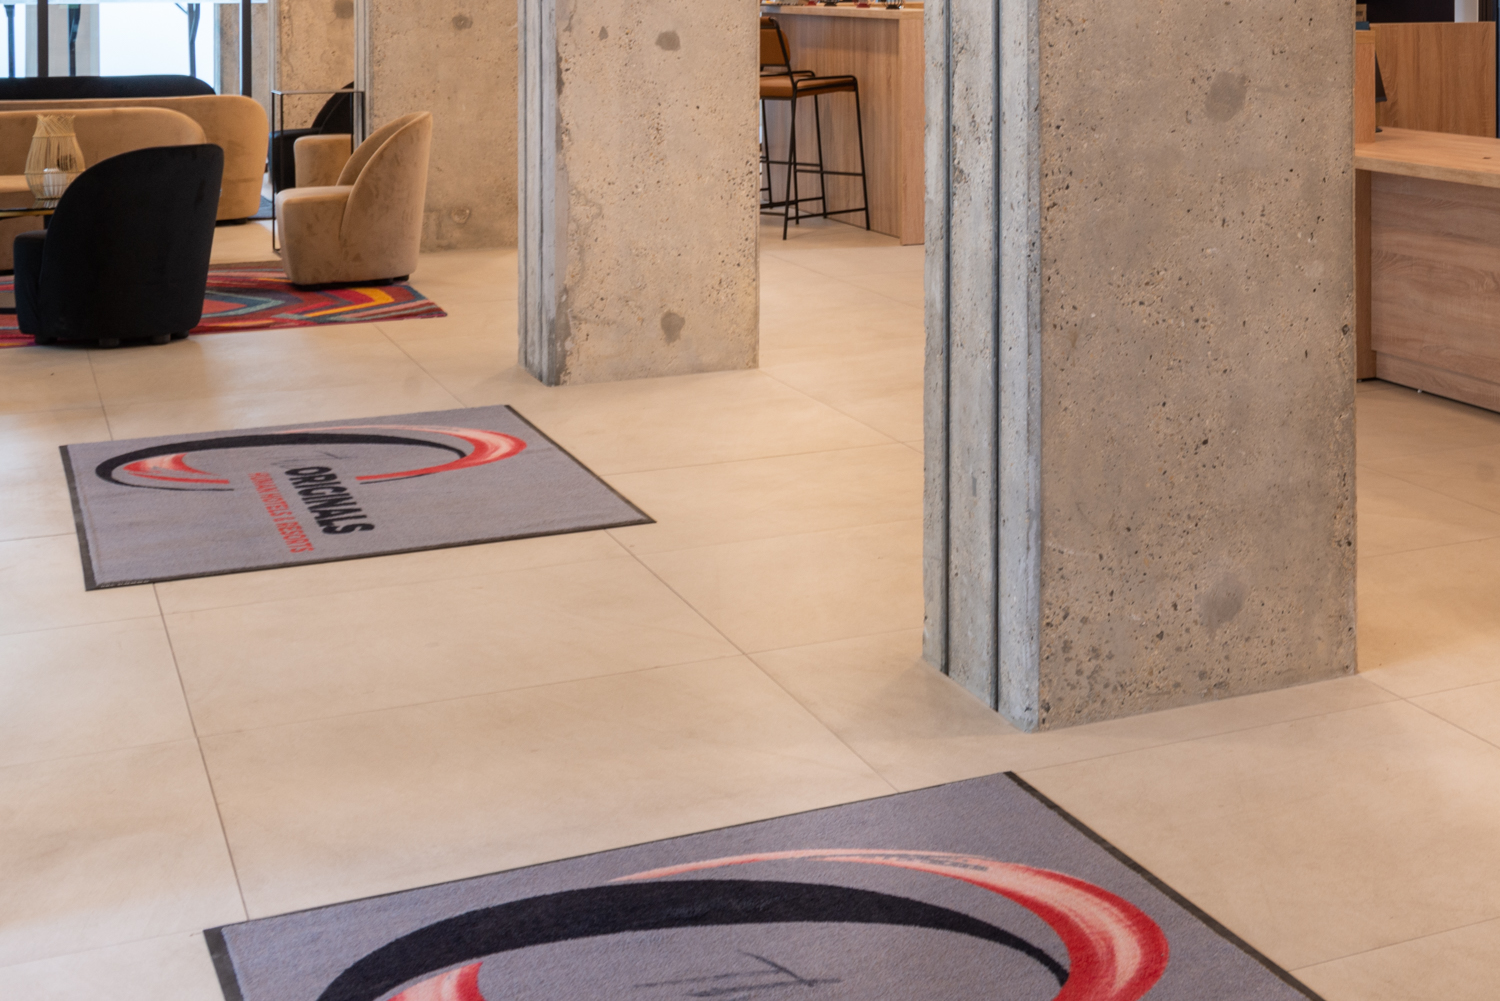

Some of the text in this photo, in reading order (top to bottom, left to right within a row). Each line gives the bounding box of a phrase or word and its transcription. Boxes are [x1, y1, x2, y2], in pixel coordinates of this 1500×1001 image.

[249, 473, 279, 493] HUMAN
[260, 493, 292, 517] HOTELS
[284, 466, 375, 535] ORIGINALS
[276, 521, 315, 552] RESORTS
